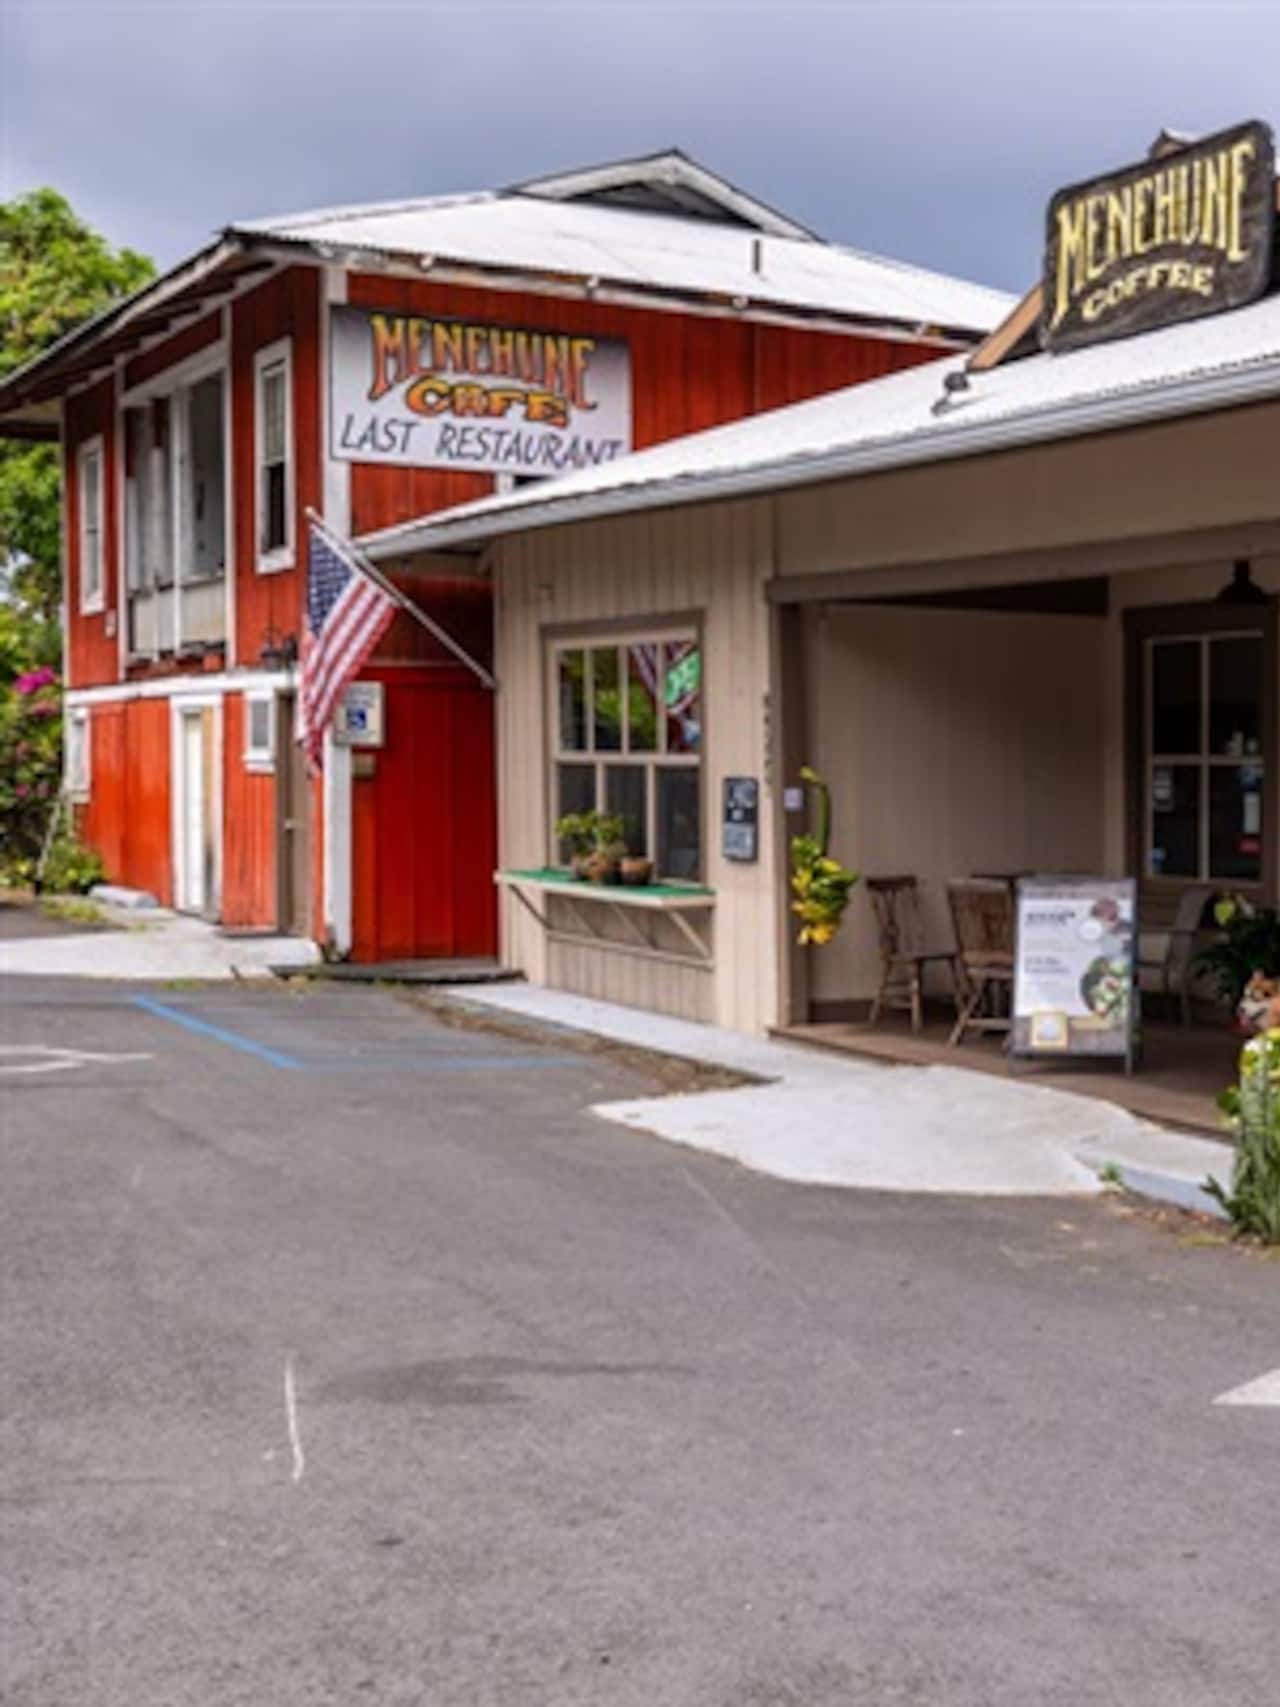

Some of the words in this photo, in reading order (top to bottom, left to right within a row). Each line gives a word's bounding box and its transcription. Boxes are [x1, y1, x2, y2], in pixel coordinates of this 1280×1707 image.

[1051, 141, 1256, 332] MENEHUNE
[1082, 261, 1214, 320] COFFEE
[367, 312, 598, 411] MENEHUNE
[405, 374, 569, 429] CAFE
[340, 413, 419, 454] LAST
[435, 424, 623, 468] RESTAURANT
